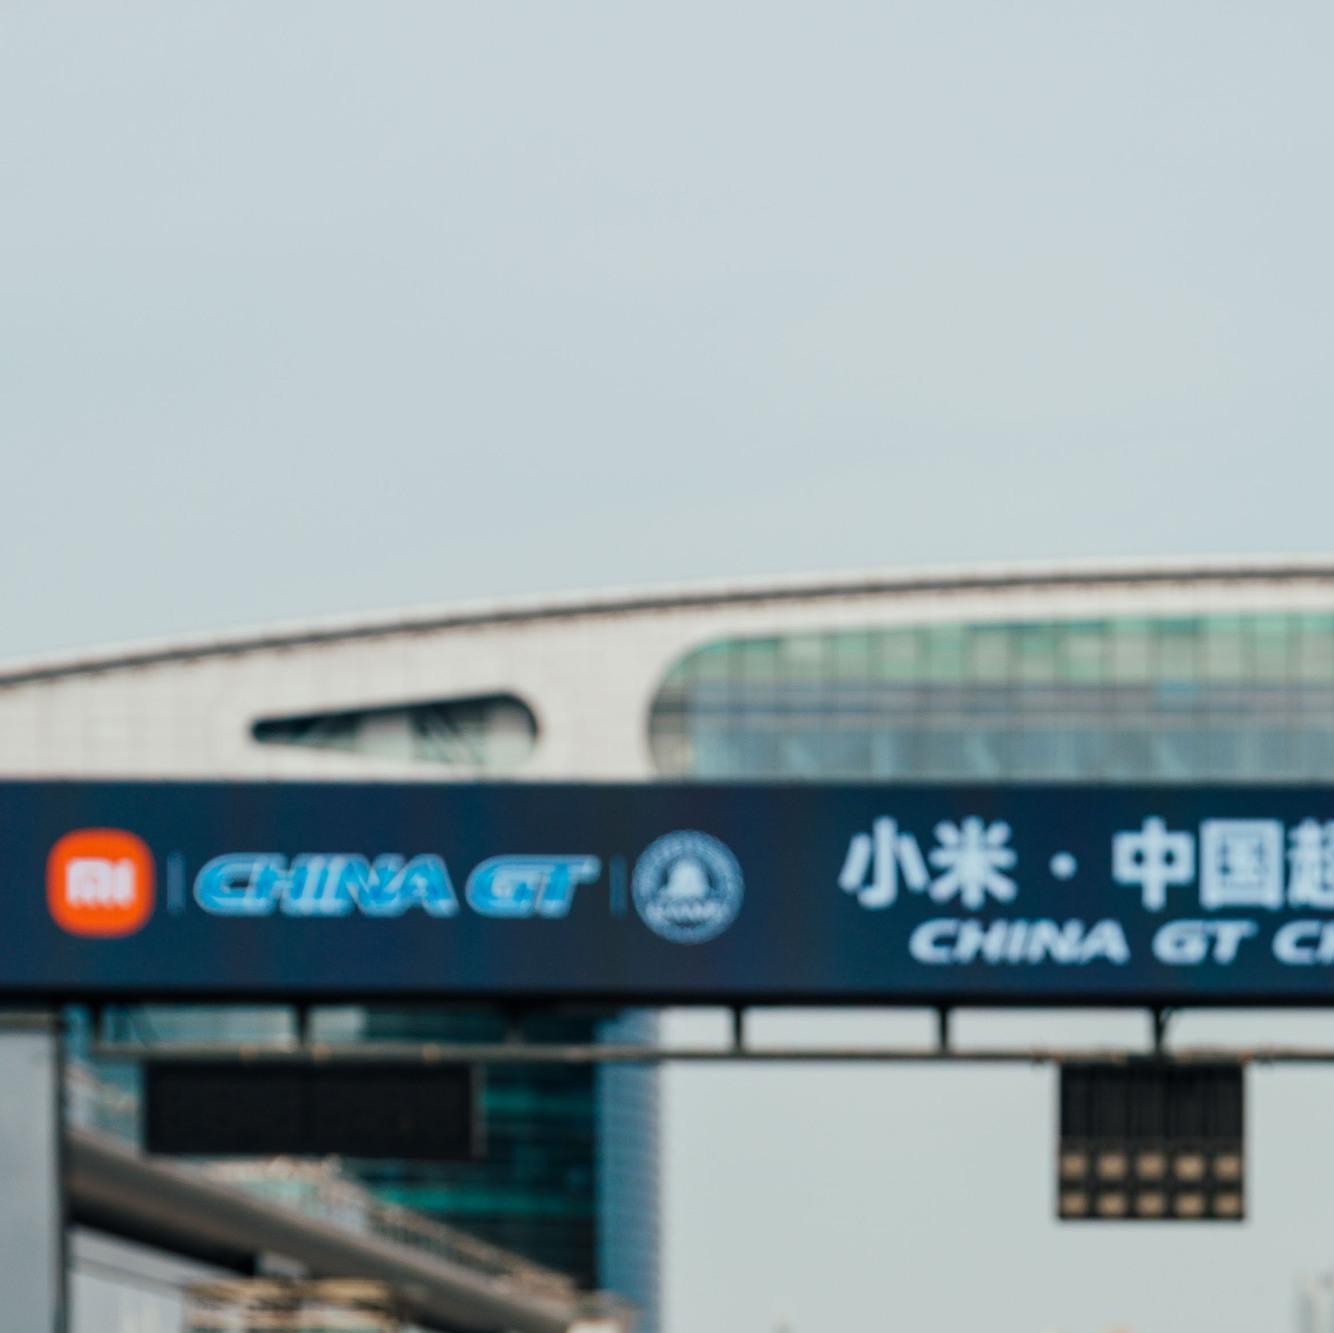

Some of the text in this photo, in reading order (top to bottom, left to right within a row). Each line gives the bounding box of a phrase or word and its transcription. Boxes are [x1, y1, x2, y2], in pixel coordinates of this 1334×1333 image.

[194, 853, 459, 916] CHINA
[465, 854, 600, 917] GT
[909, 920, 1128, 963] CHINA
[1153, 921, 1255, 963] GT
